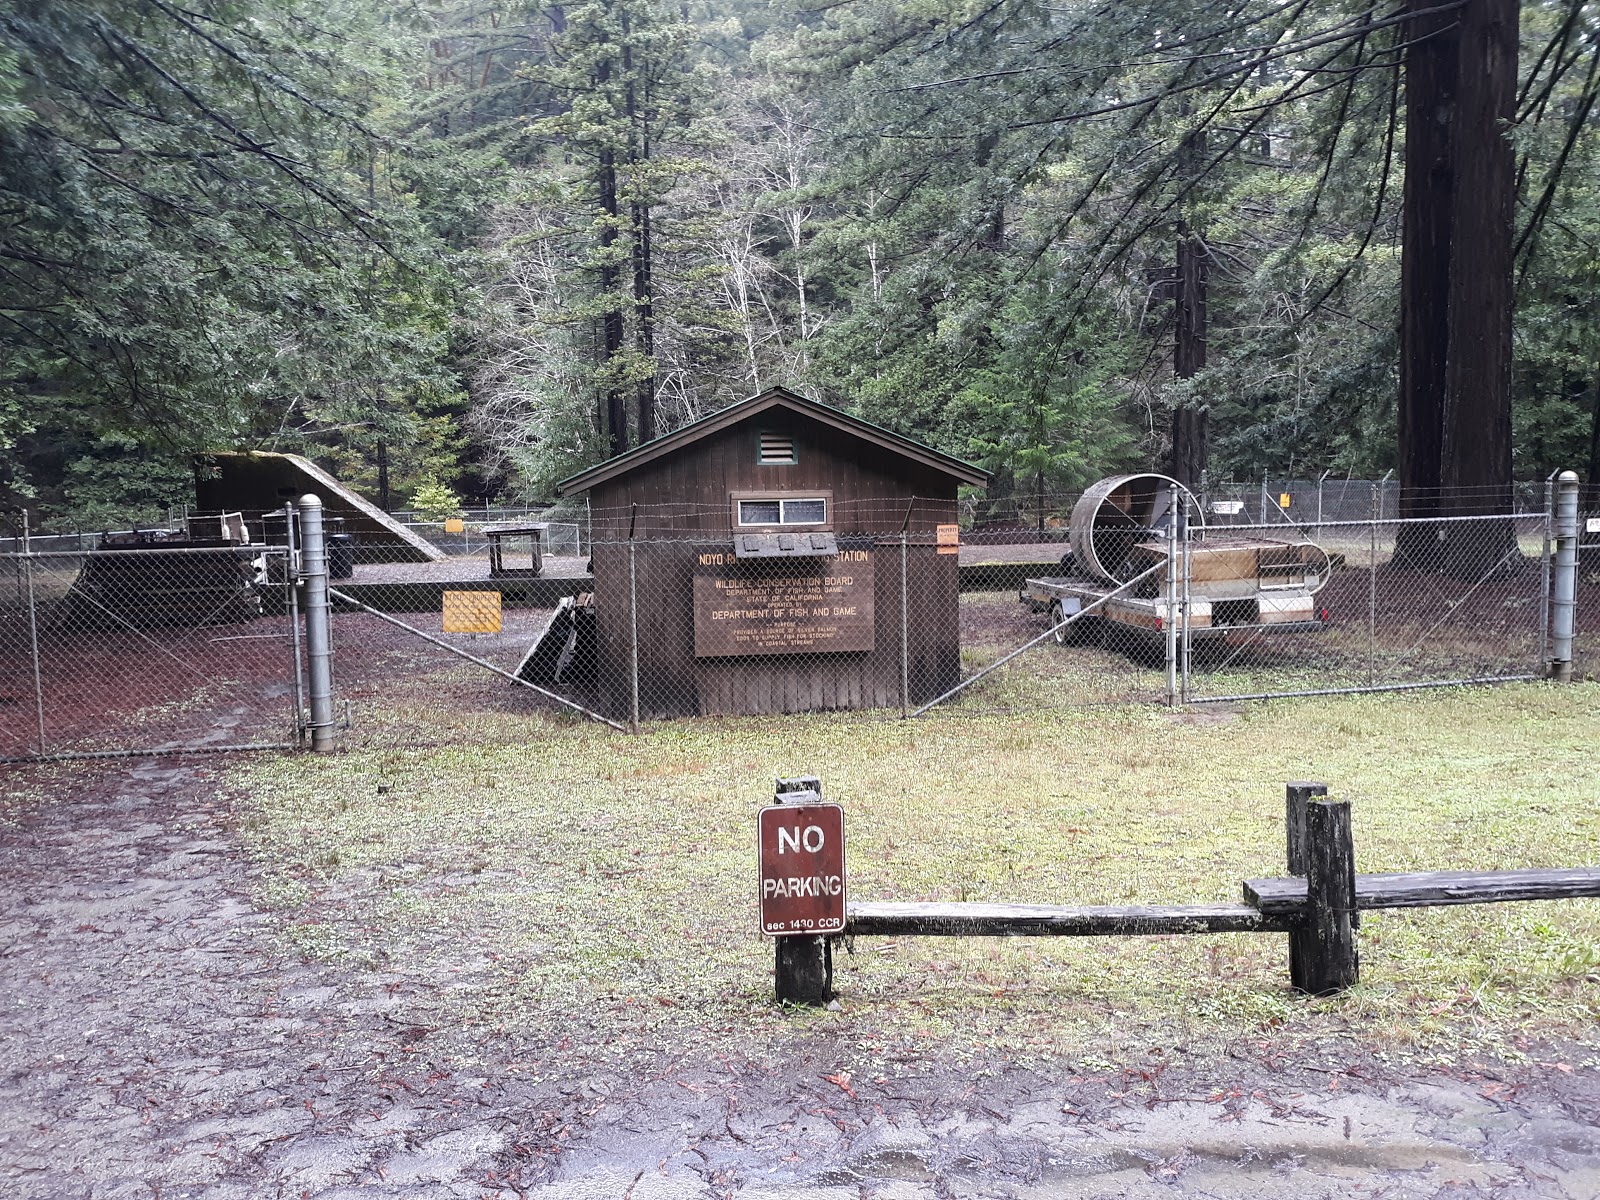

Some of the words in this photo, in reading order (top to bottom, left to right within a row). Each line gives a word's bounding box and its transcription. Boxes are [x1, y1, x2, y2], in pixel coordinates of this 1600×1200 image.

[699, 553, 724, 566] NOYO
[833, 551, 868, 562] STATION
[715, 578, 752, 589] WILDLIFE
[758, 578, 821, 588] CONSERVATION
[824, 576, 854, 586] BOARD
[726, 588, 771, 596] DEPARTMENT
[712, 610, 770, 620] DEPARTMENT
[774, 608, 785, 618] OF
[789, 608, 809, 617] FISH
[812, 608, 830, 616] AND
[833, 606, 857, 616] GAME
[778, 825, 825, 854] NO
[764, 875, 842, 899] PARKING
[790, 919, 814, 929] 1430
[818, 918, 840, 928] CCR
